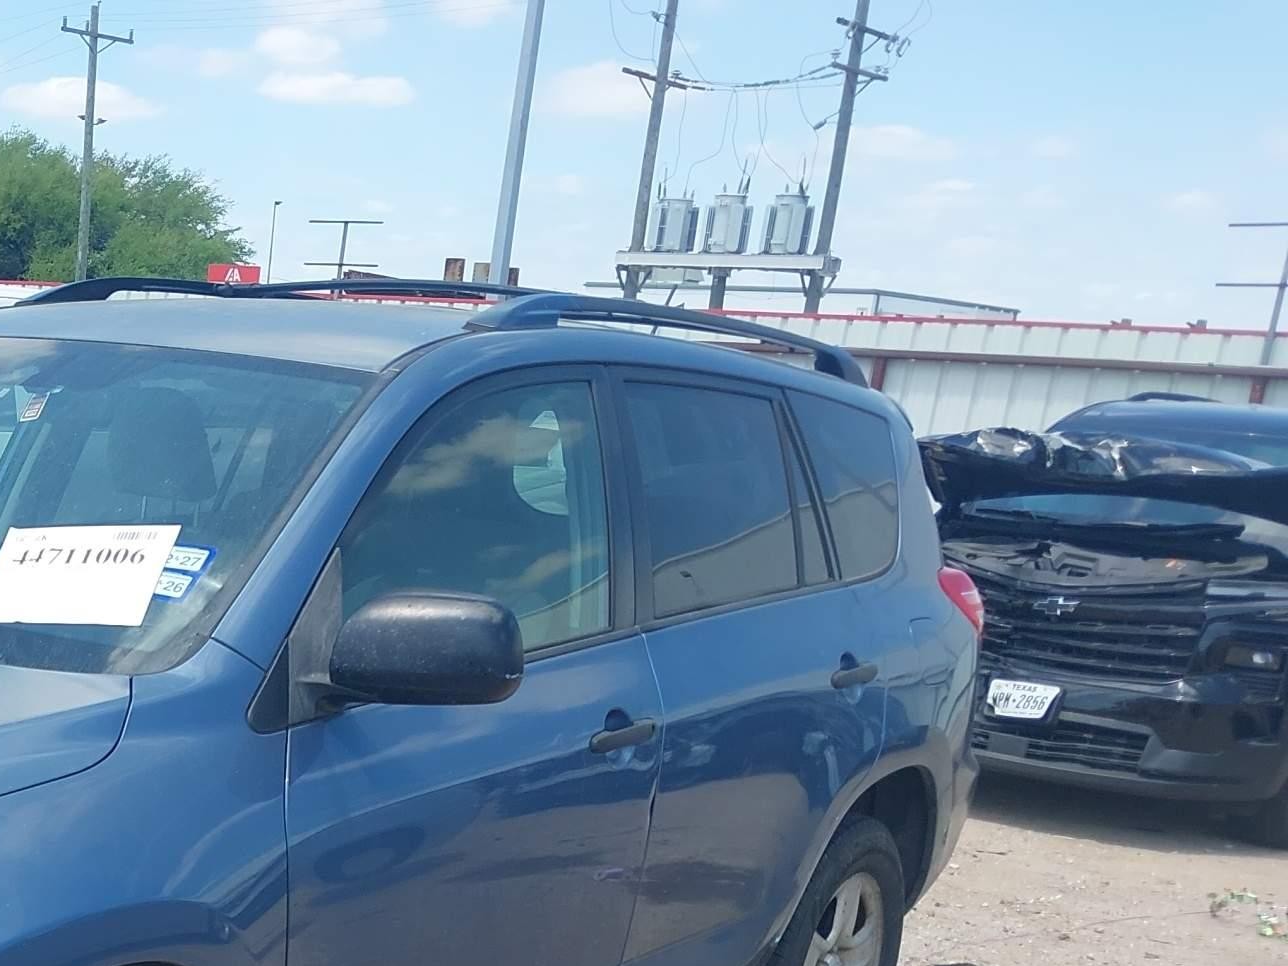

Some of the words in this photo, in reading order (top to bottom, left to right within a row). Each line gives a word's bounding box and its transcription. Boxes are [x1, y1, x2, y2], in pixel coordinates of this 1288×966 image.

[12, 547, 146, 566] 44711006
[179, 555, 202, 567] 27
[163, 580, 185, 593] 26
[1012, 683, 1038, 693] TEXAS
